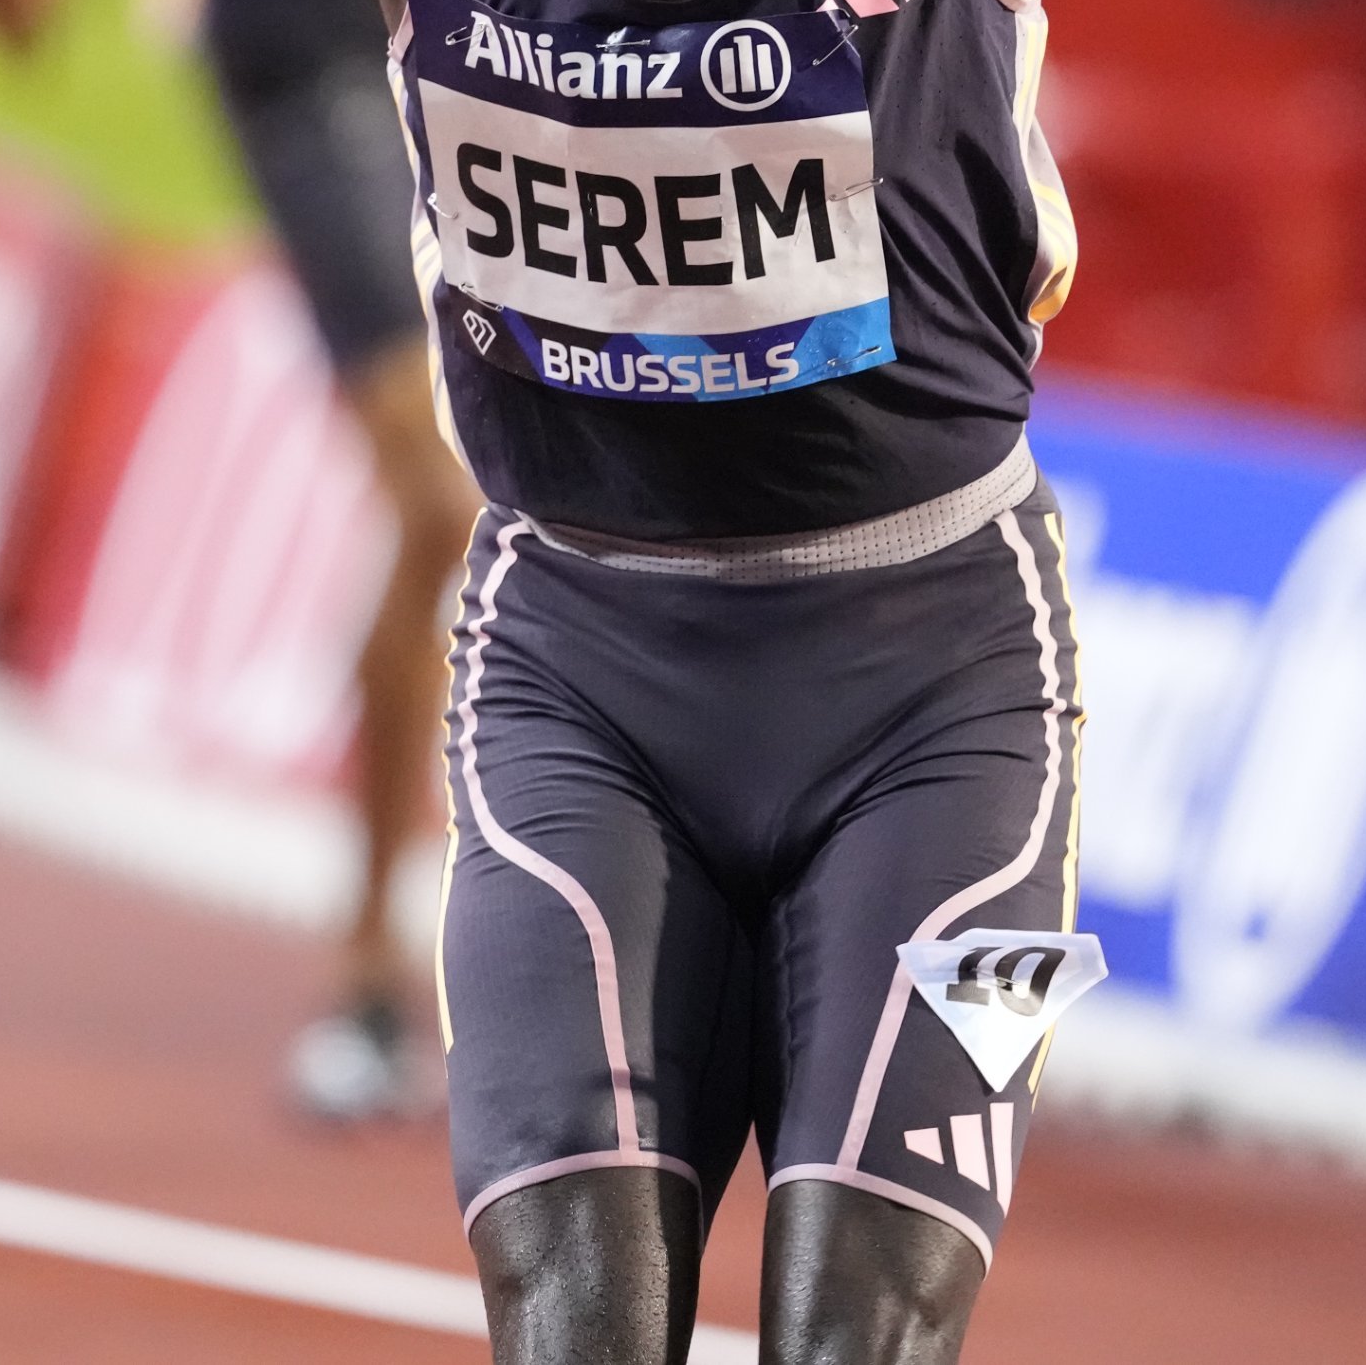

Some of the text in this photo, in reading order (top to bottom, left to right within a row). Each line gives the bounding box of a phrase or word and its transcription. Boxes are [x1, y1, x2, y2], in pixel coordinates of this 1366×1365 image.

[464, 10, 683, 100] Allianz
[455, 141, 837, 287] SEREM
[540, 337, 800, 394] BRUSSELS
[945, 945, 1066, 1017] 10
